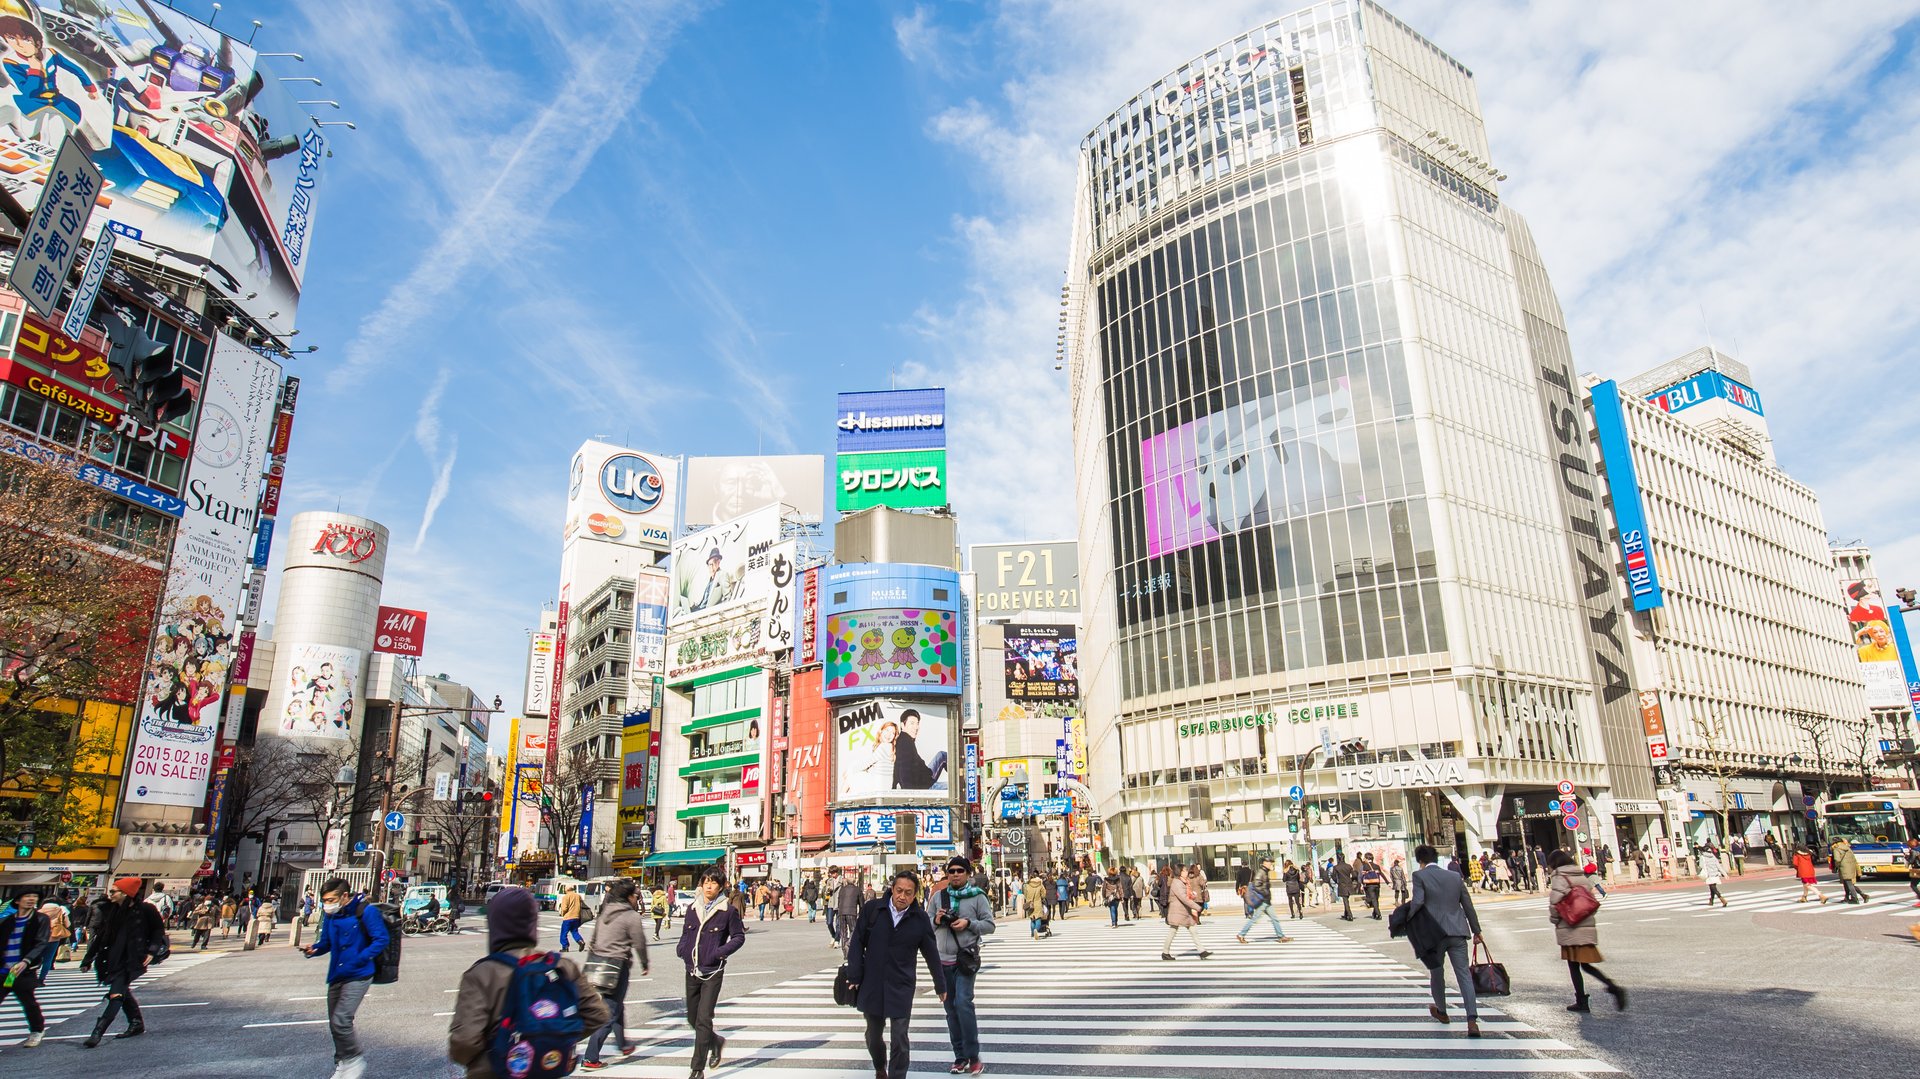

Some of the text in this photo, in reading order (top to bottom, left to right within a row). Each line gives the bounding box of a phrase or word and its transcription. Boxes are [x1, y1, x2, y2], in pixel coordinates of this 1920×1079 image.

[25, 170, 69, 261] Shibuya Sta.
[32, 167, 94, 302] 渋谷駅前
[112, 223, 138, 237] 検索
[1722, 379, 1760, 412] SEIBU
[838, 412, 943, 429] Hisamitsu
[77, 465, 182, 512] 会話イーオン
[841, 466, 941, 490] サロンパス
[186, 479, 253, 531] Star!!
[266, 487, 278, 508] ガスト
[188, 534, 220, 549] CINDERELLA
[327, 522, 376, 538] SHIBUYA
[643, 528, 668, 540] VISA
[1541, 363, 1631, 706] TSUTAYA
[184, 542, 238, 566] ANIMATION
[311, 530, 376, 563] 109
[189, 555, 230, 575] PROJECT
[997, 549, 1054, 587] F21
[1621, 529, 1653, 599] SEIBU
[200, 571, 213, 585] 01
[246, 578, 261, 622] 渋谷駅前ビル
[768, 553, 793, 645] もんじゃ
[977, 589, 1077, 610] FOREVER 21
[383, 612, 416, 633] H&M
[393, 642, 416, 651] 150m
[641, 645, 657, 654] まで
[648, 659, 663, 668] 地下
[529, 653, 546, 712] Essential
[839, 702, 884, 734] DMM
[1180, 702, 1359, 737] STARBUCKS COFFEE
[848, 725, 876, 751] FX
[137, 744, 209, 766] 2015.02.18
[791, 731, 824, 791] クスリ
[1653, 744, 1665, 756] 本
[135, 761, 207, 781] ON SALE!!
[743, 767, 759, 784] JTB
[1342, 761, 1464, 789] TSUTAYA
[1615, 803, 1640, 812] TSUTAYA
[839, 814, 944, 837] 大盛堂店
